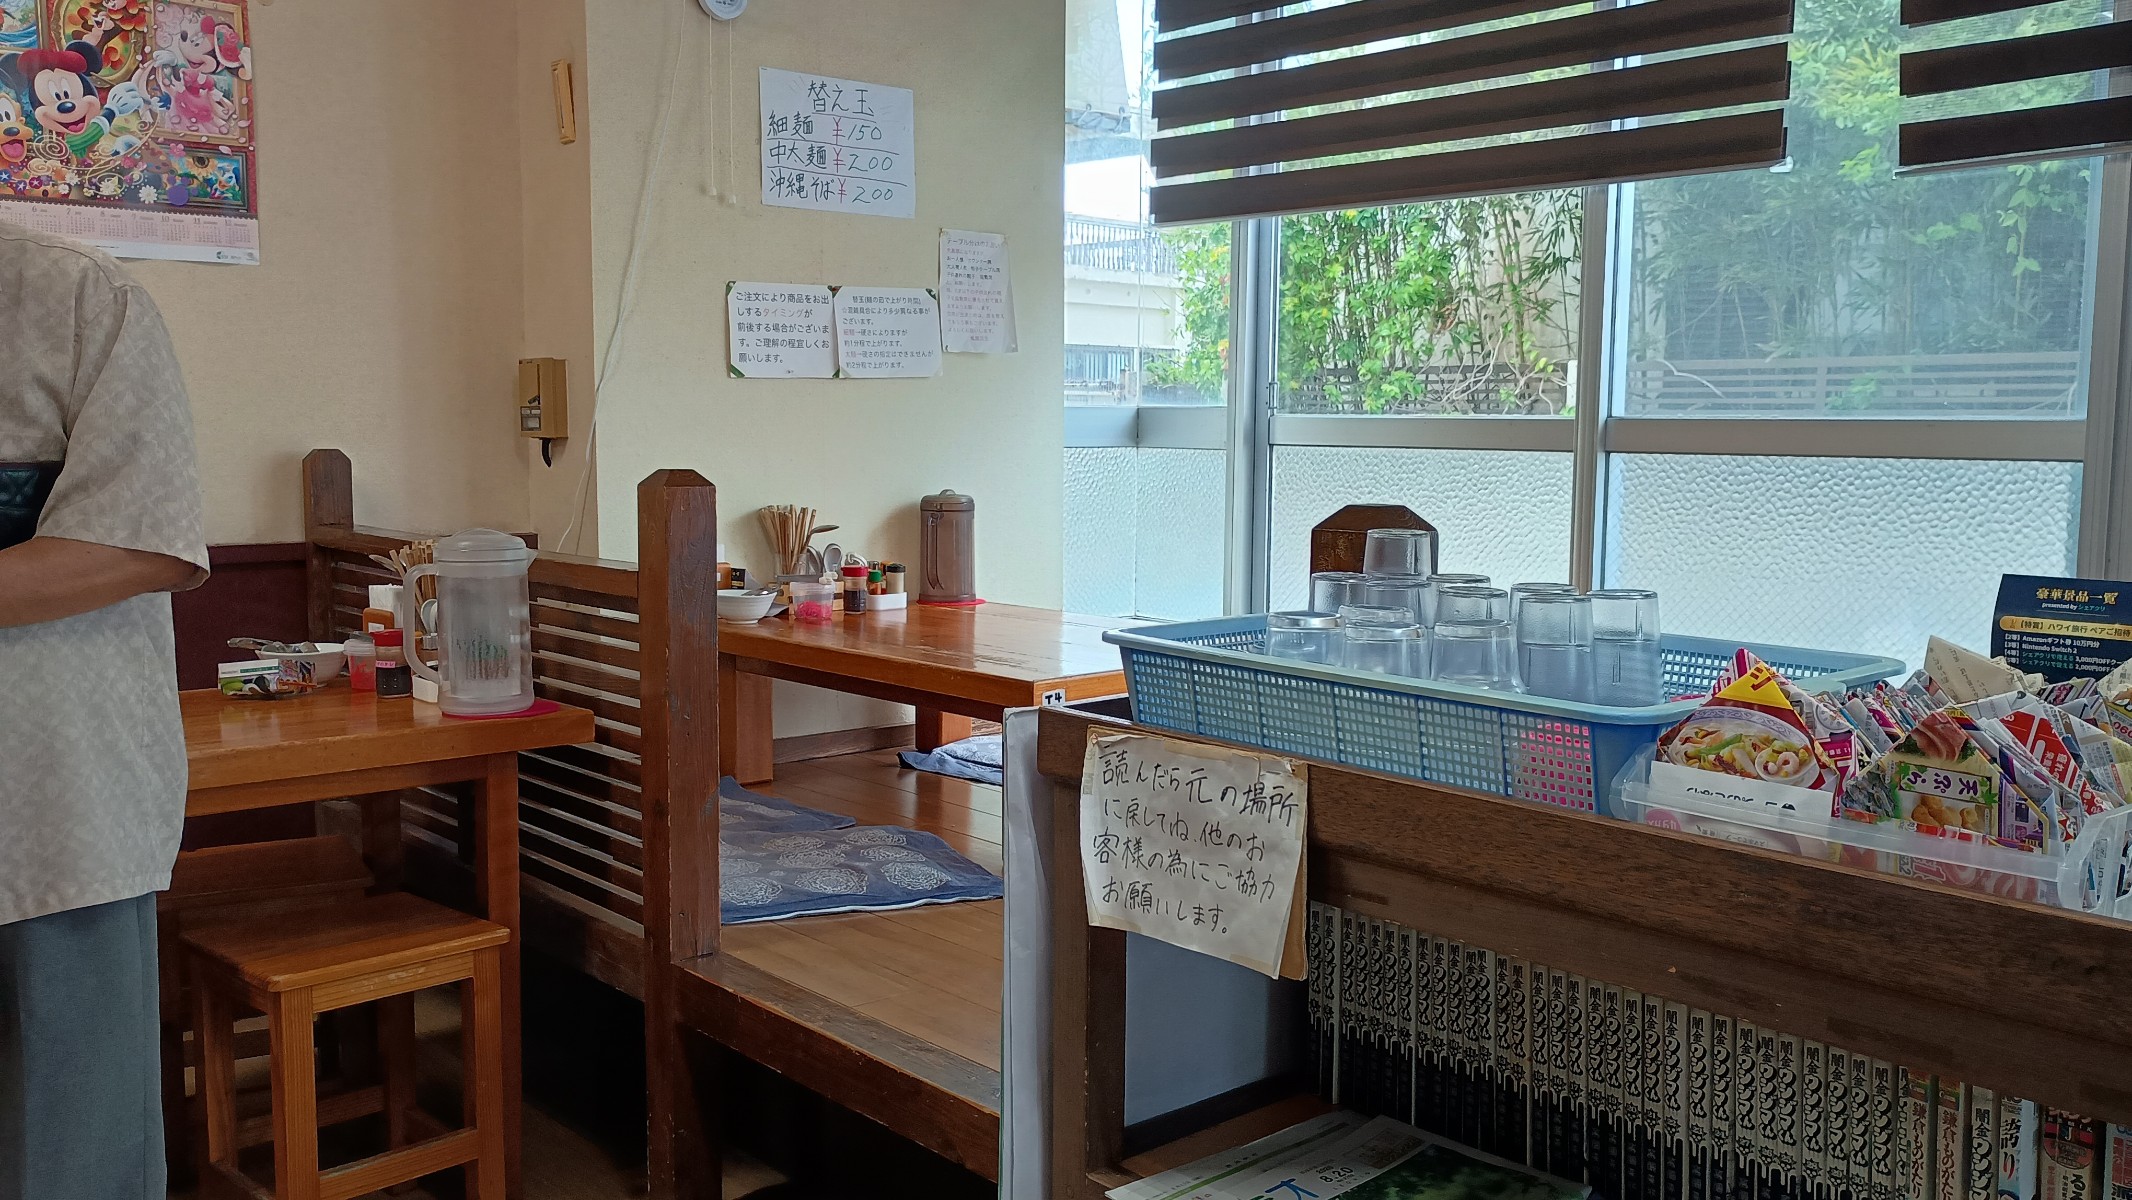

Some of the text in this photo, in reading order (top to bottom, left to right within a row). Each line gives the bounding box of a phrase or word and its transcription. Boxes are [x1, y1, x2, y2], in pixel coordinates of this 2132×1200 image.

[808, 80, 875, 117] 替え玉
[767, 110, 882, 145] 細麺 ¥150
[769, 141, 893, 173] 中太麺 ¥200
[838, 178, 893, 204] ¥200
[736, 291, 830, 304] ご注文により商品をお出
[737, 307, 813, 318] しするタイミングが
[737, 322, 830, 334] 前後する場合がございま
[738, 338, 830, 349] す。ご理解の程宜しくお
[738, 353, 784, 364] 願いします。
[2036, 588, 2119, 605] 豪華景品一覧
[1099, 745, 1299, 827] 読んだら元の場所
[1907, 771, 1979, 796] 天ぷら
[1093, 827, 1275, 903] 客様の為にご協力
[1102, 876, 1227, 934] お願いします。
[1912, 1101, 1927, 1199] 鎌倉ものがたり
